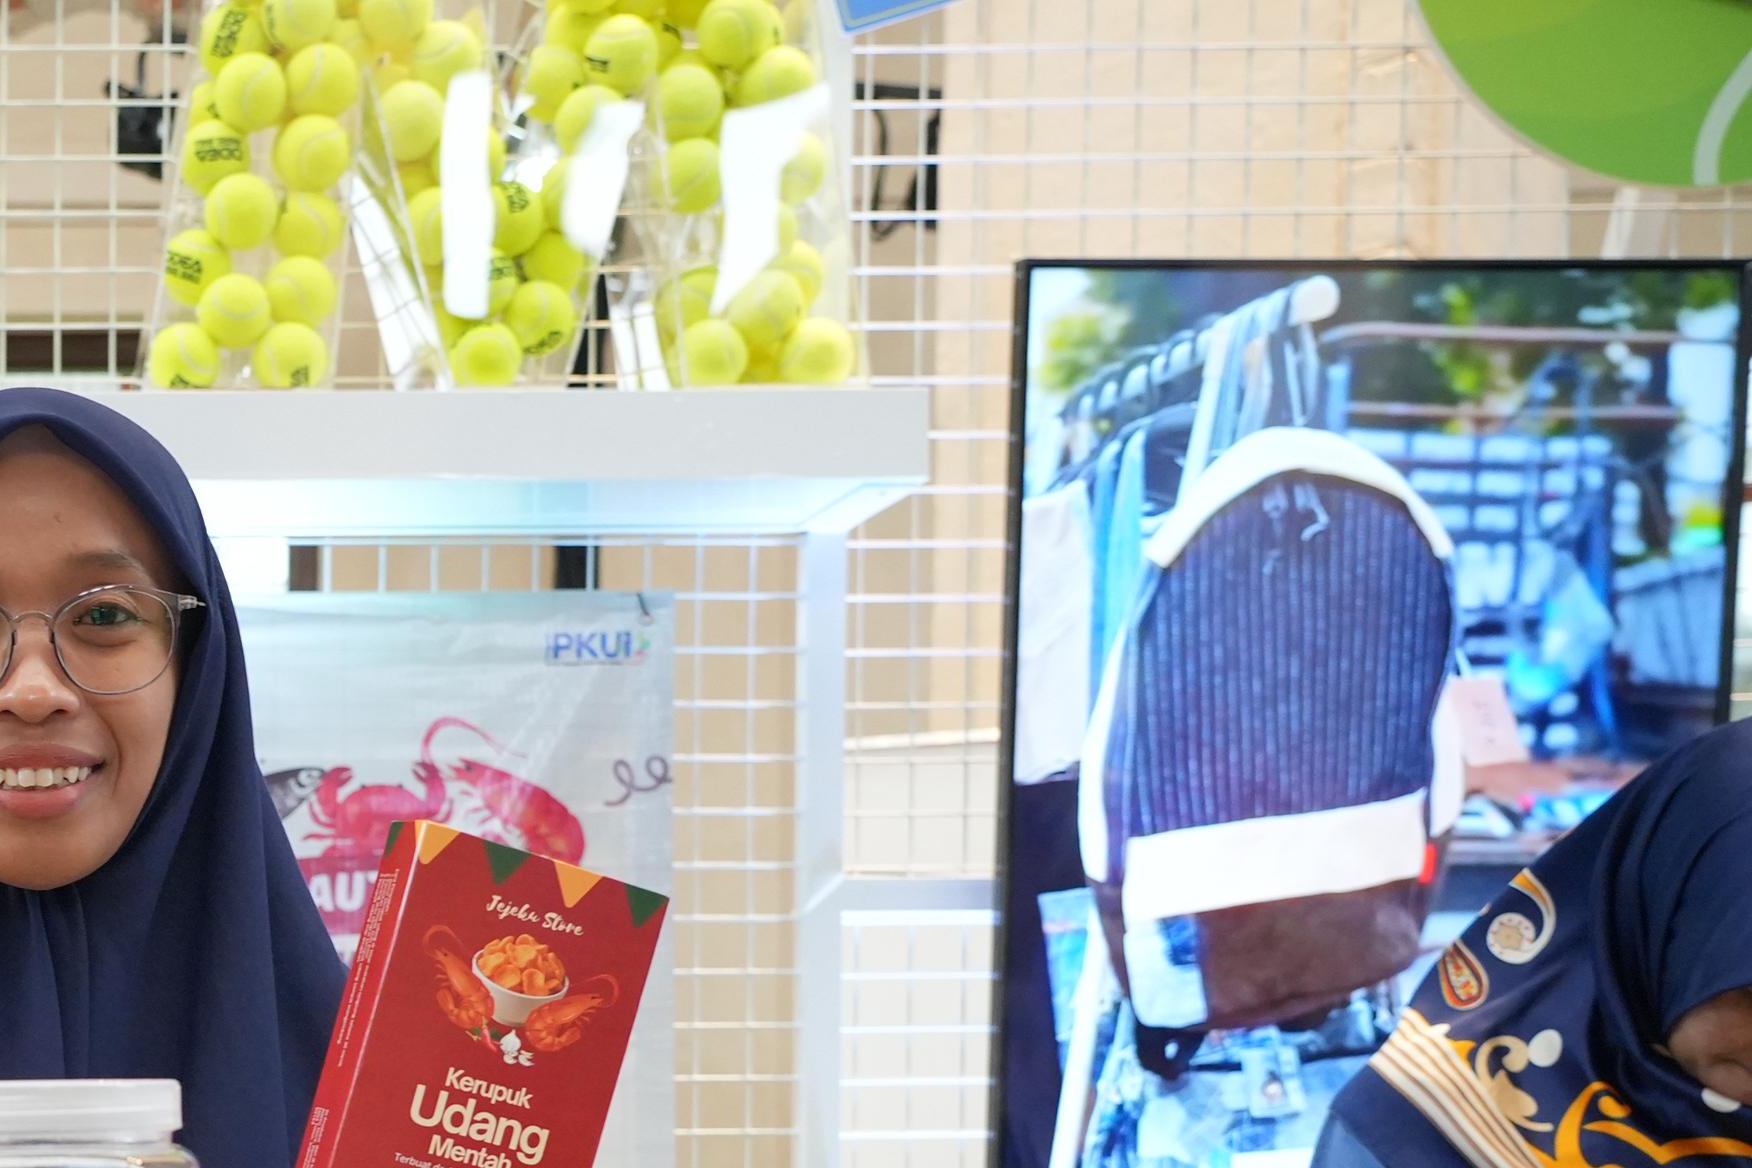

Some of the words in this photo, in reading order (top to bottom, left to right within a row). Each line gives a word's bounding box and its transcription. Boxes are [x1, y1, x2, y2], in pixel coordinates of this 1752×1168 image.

[308, 869, 379, 913] AU
[543, 911, 584, 937] Store
[445, 1066, 535, 1110] Kerupuk
[409, 1083, 551, 1166] Udang
